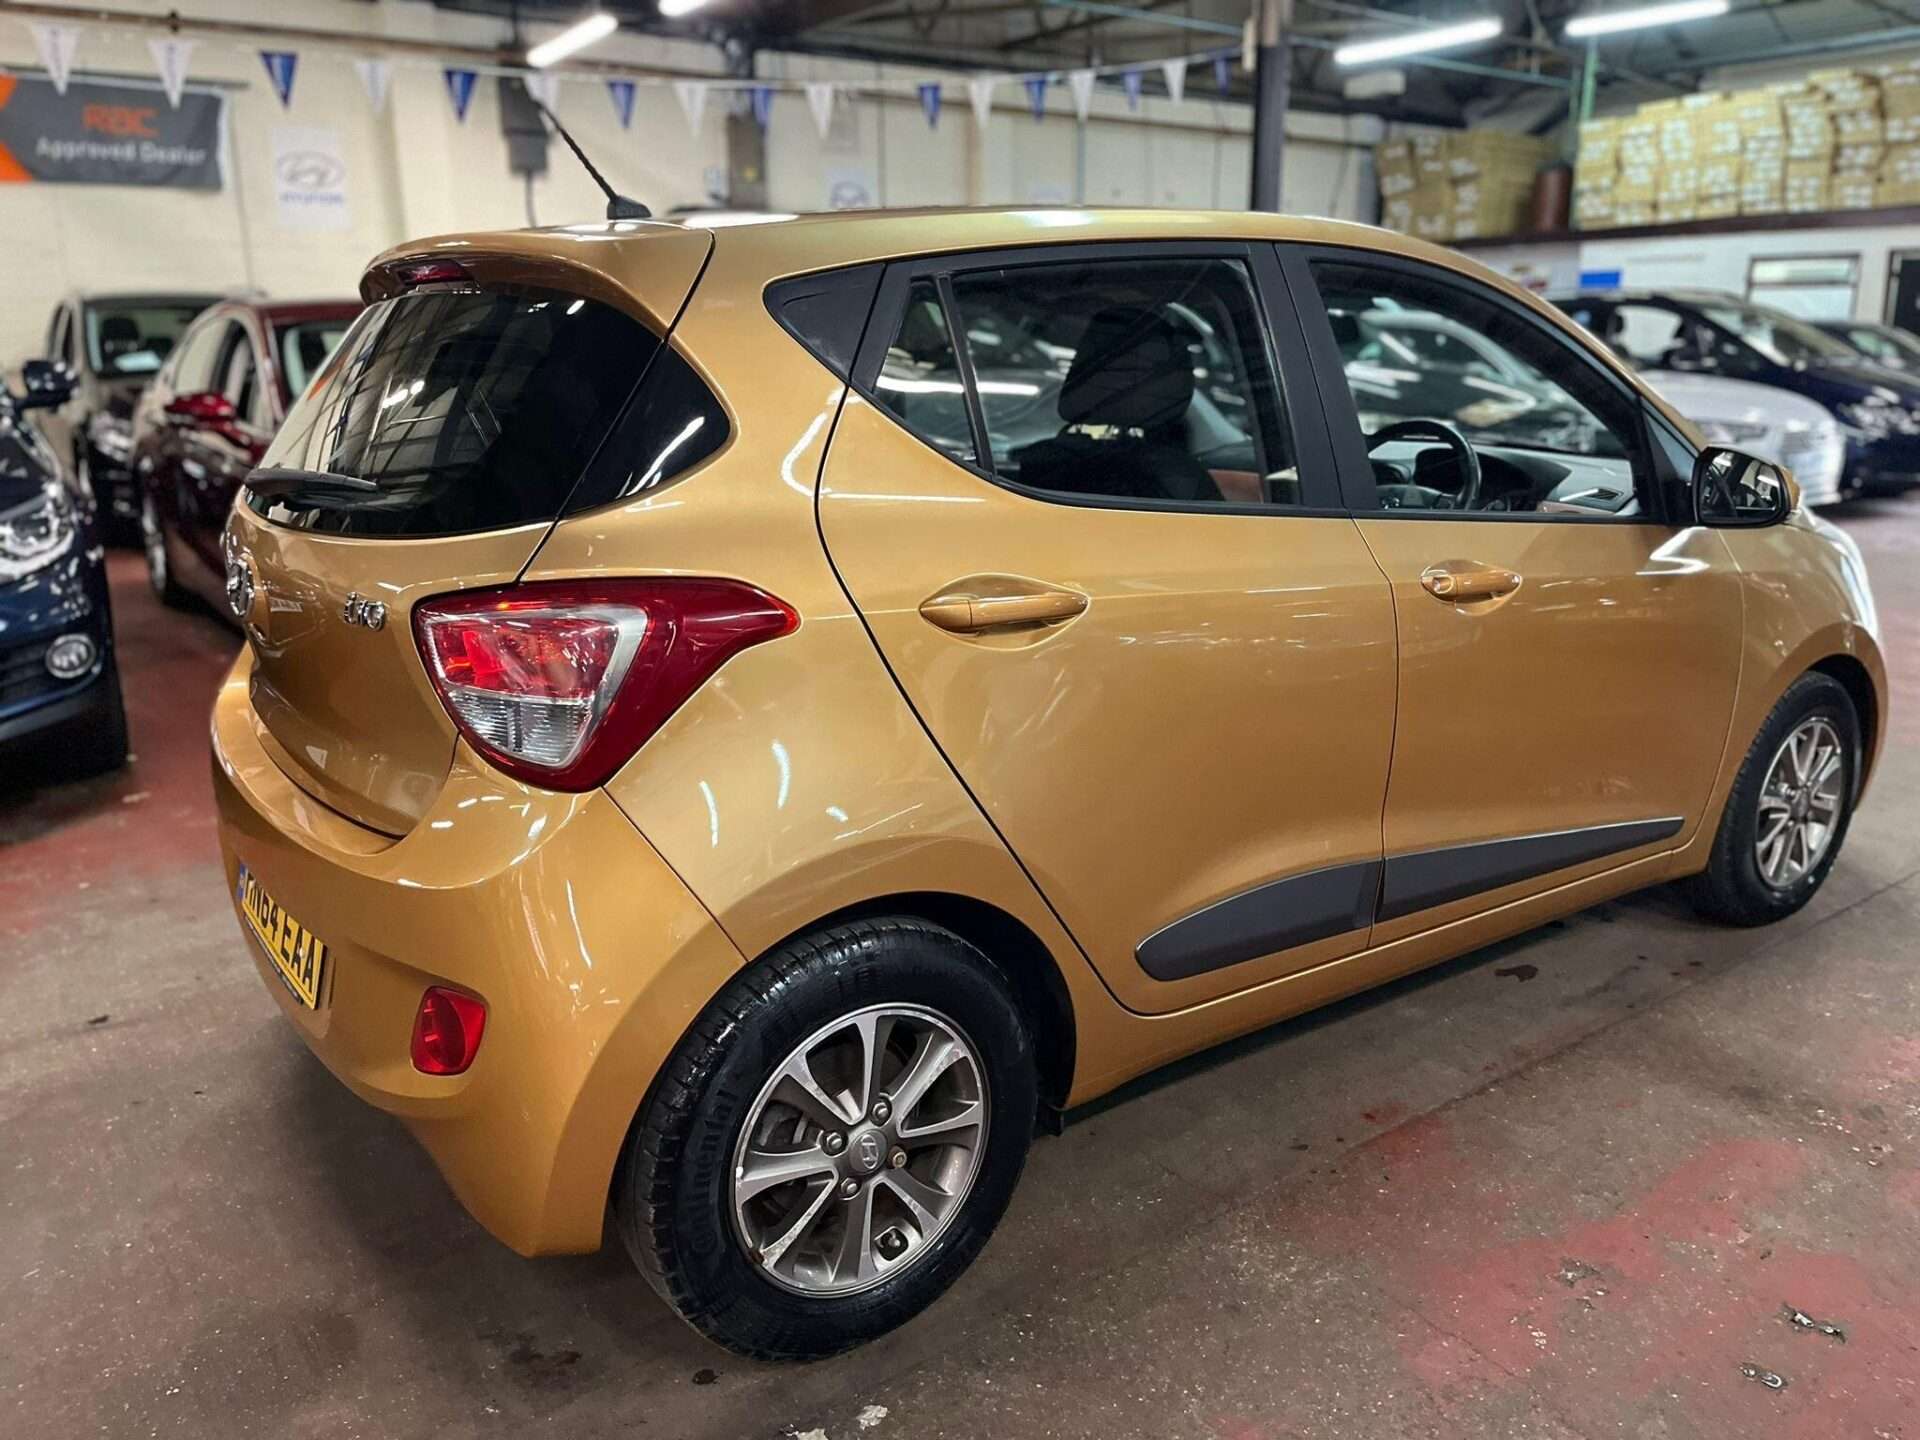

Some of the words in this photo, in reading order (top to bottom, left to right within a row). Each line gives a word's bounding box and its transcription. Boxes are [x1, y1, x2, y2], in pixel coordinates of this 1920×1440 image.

[36, 136, 136, 163] Approved
[139, 140, 206, 167] Dealer
[280, 912, 316, 994] EAA
